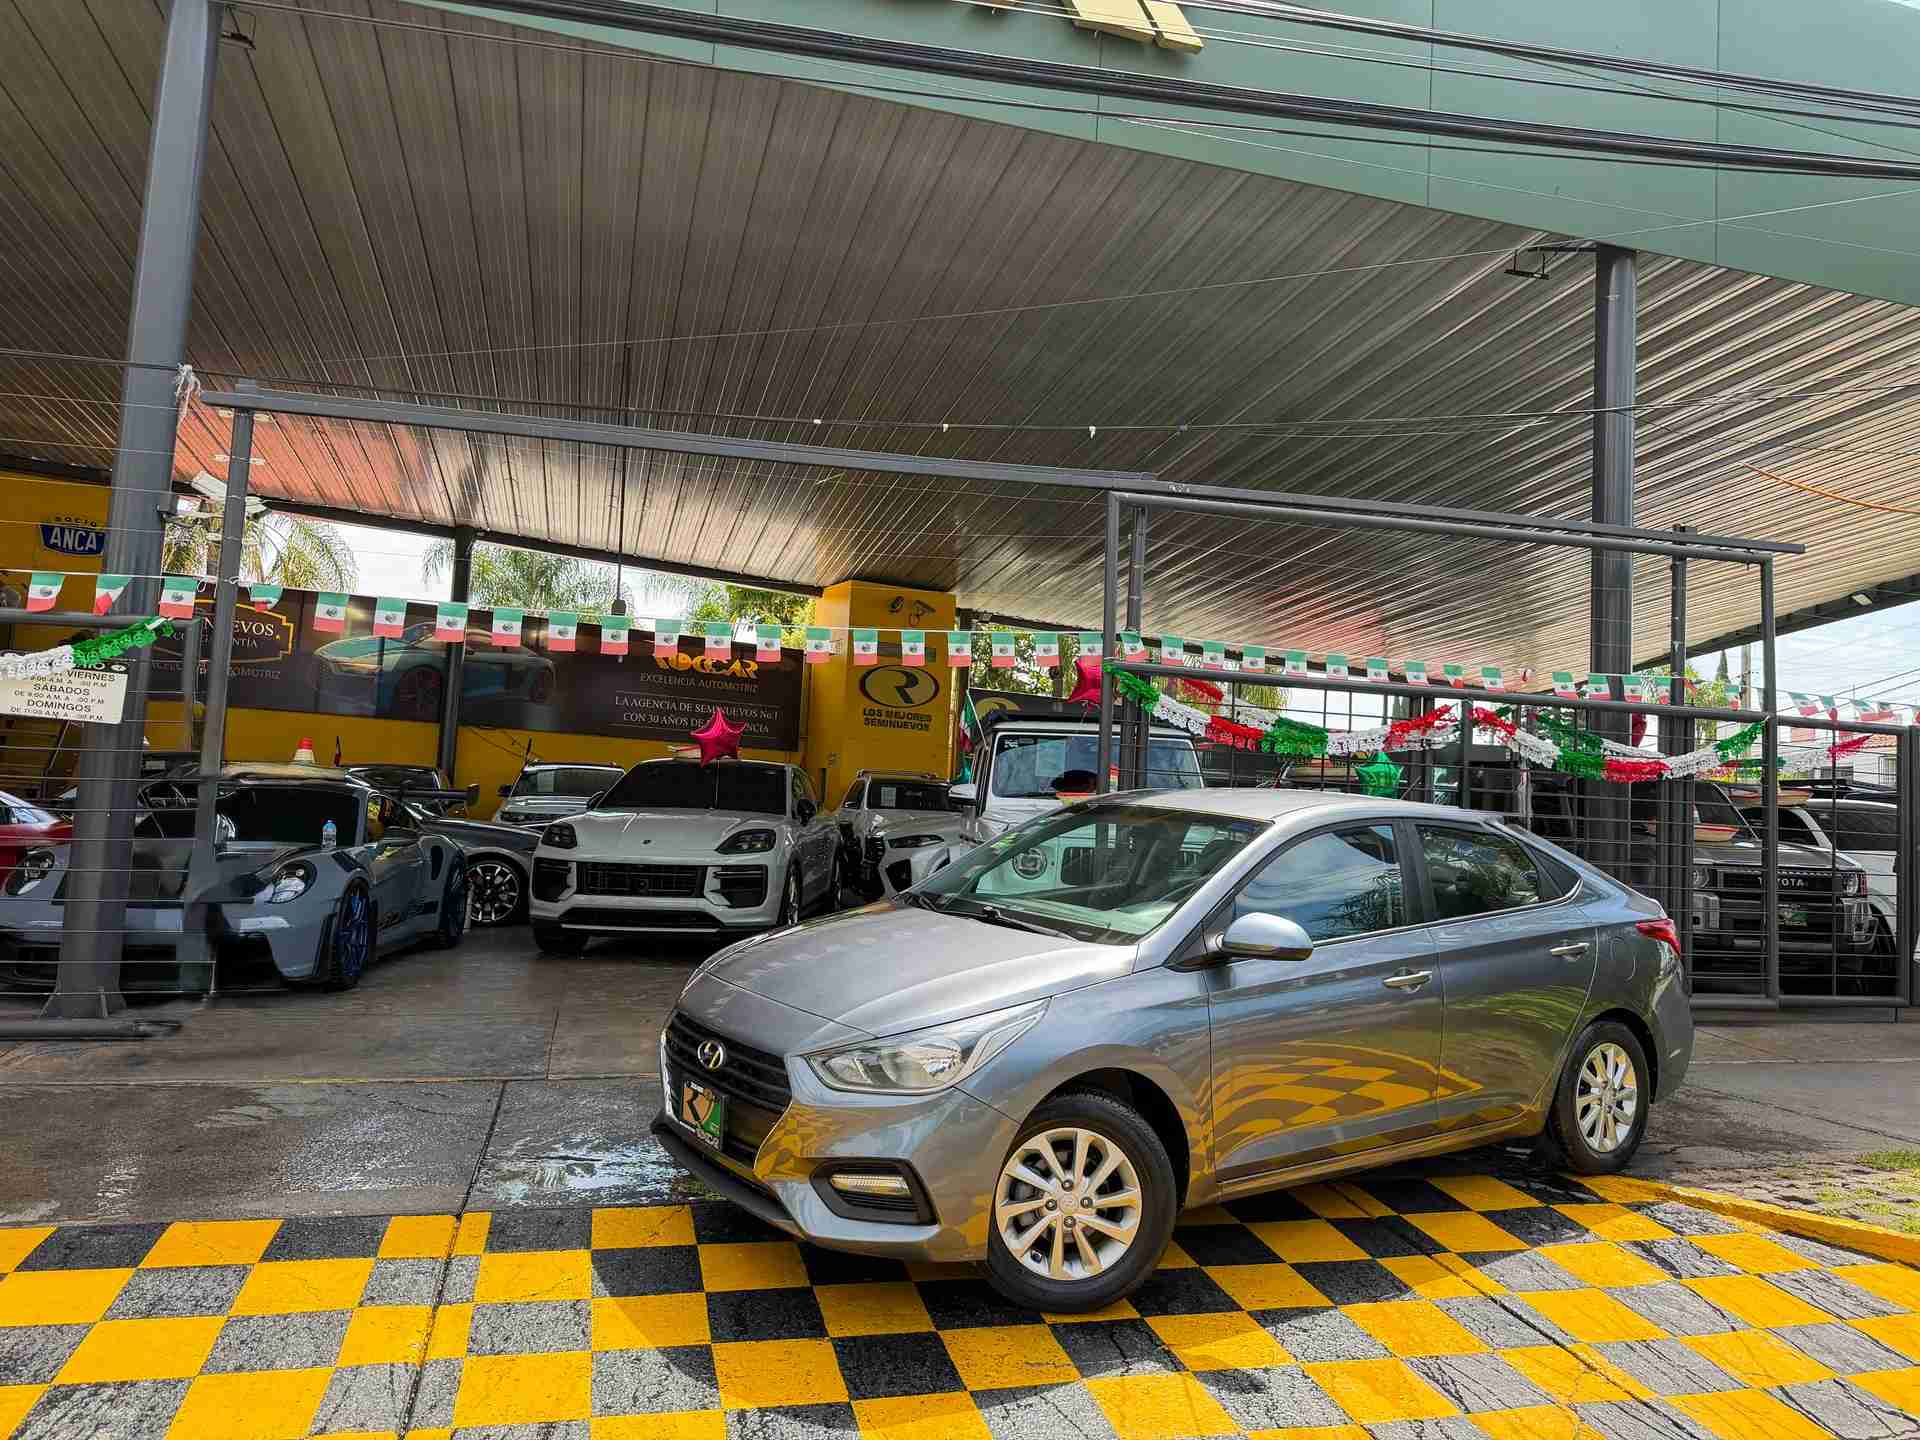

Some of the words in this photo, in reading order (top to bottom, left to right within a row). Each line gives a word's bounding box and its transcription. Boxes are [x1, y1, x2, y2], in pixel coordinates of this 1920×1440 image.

[66, 670, 116, 682] VIERNES
[27, 699, 92, 712] DOMINGOS
[615, 696, 631, 707] LA
[631, 697, 678, 711] AGENCIA
[679, 703, 694, 712] DE
[624, 712, 646, 722] CON
[863, 708, 882, 717] LOS
[863, 717, 930, 732] SEMINUEVOS
